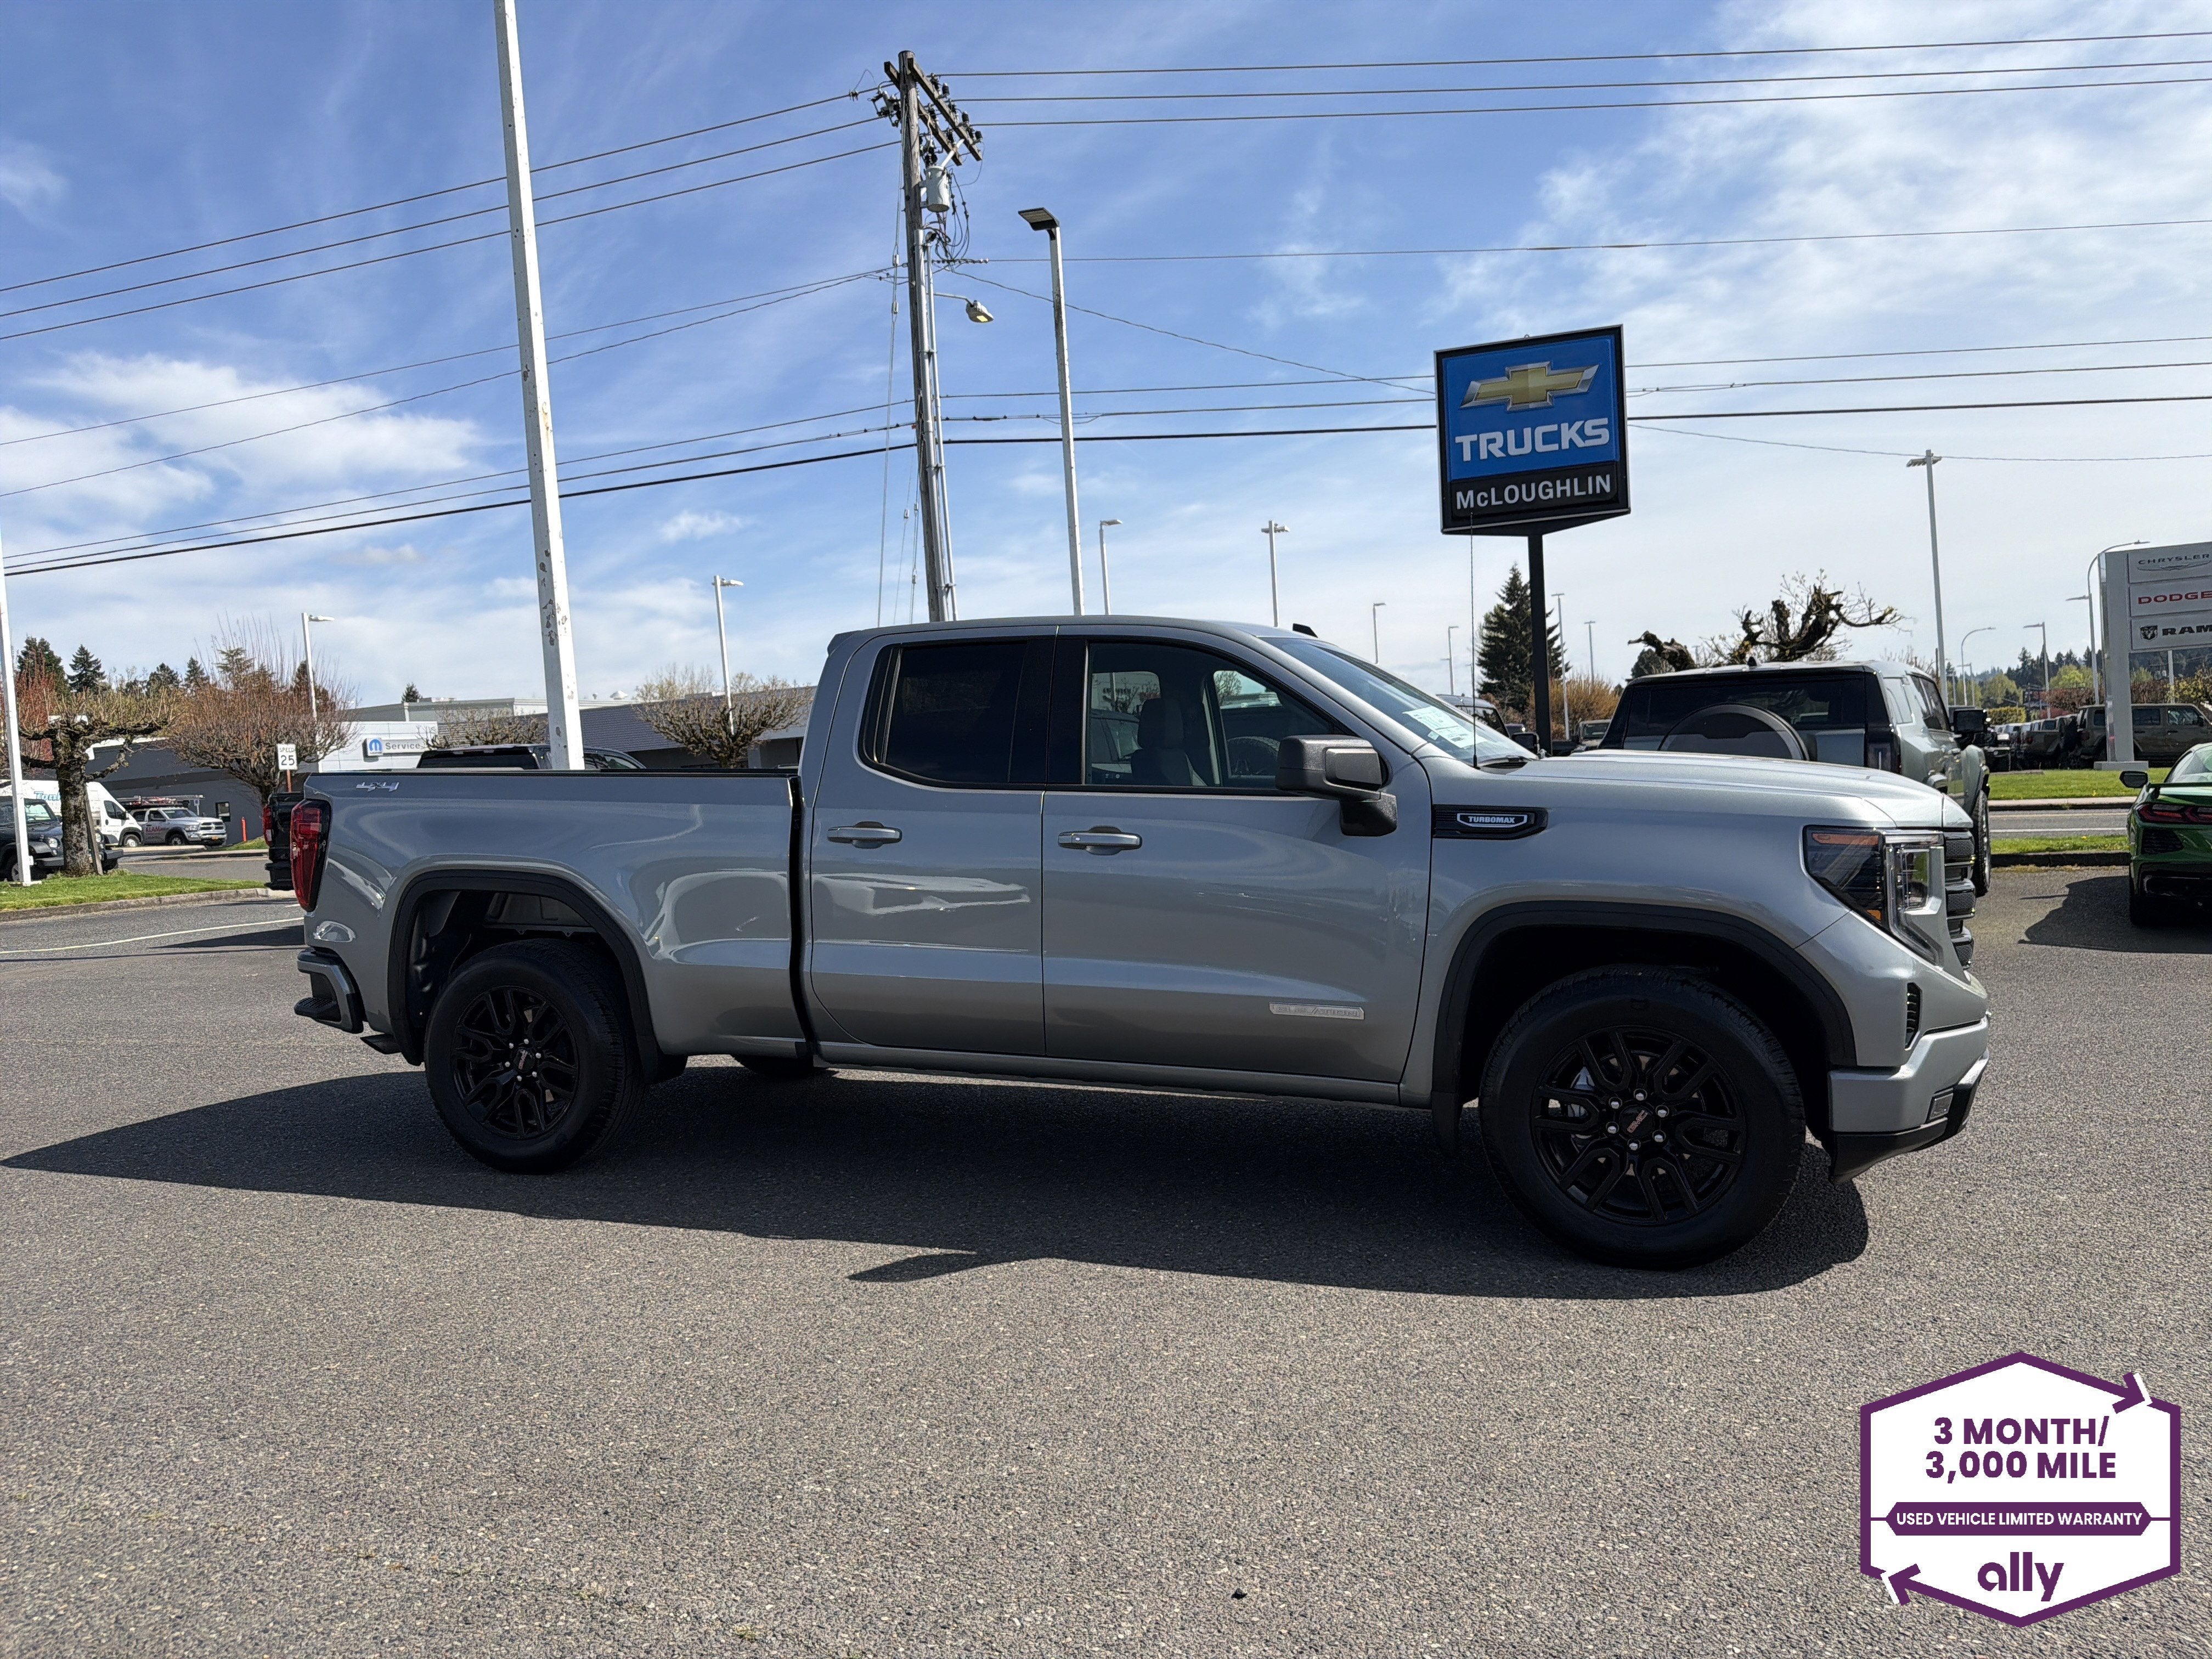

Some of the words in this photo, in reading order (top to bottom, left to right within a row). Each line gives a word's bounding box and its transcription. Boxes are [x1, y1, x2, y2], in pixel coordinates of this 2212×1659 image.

[1455, 417, 1610, 462] TRUCKS
[1456, 474, 1611, 510] McLOUGHLIN
[2138, 554, 2210, 565] CHRYSLER
[2138, 590, 2212, 605] DODGE
[2162, 624, 2212, 636] RAM
[280, 754, 295, 766] 25
[1468, 815, 1515, 824] TURBOMAX
[1627, 1109, 1648, 1133] GMC
